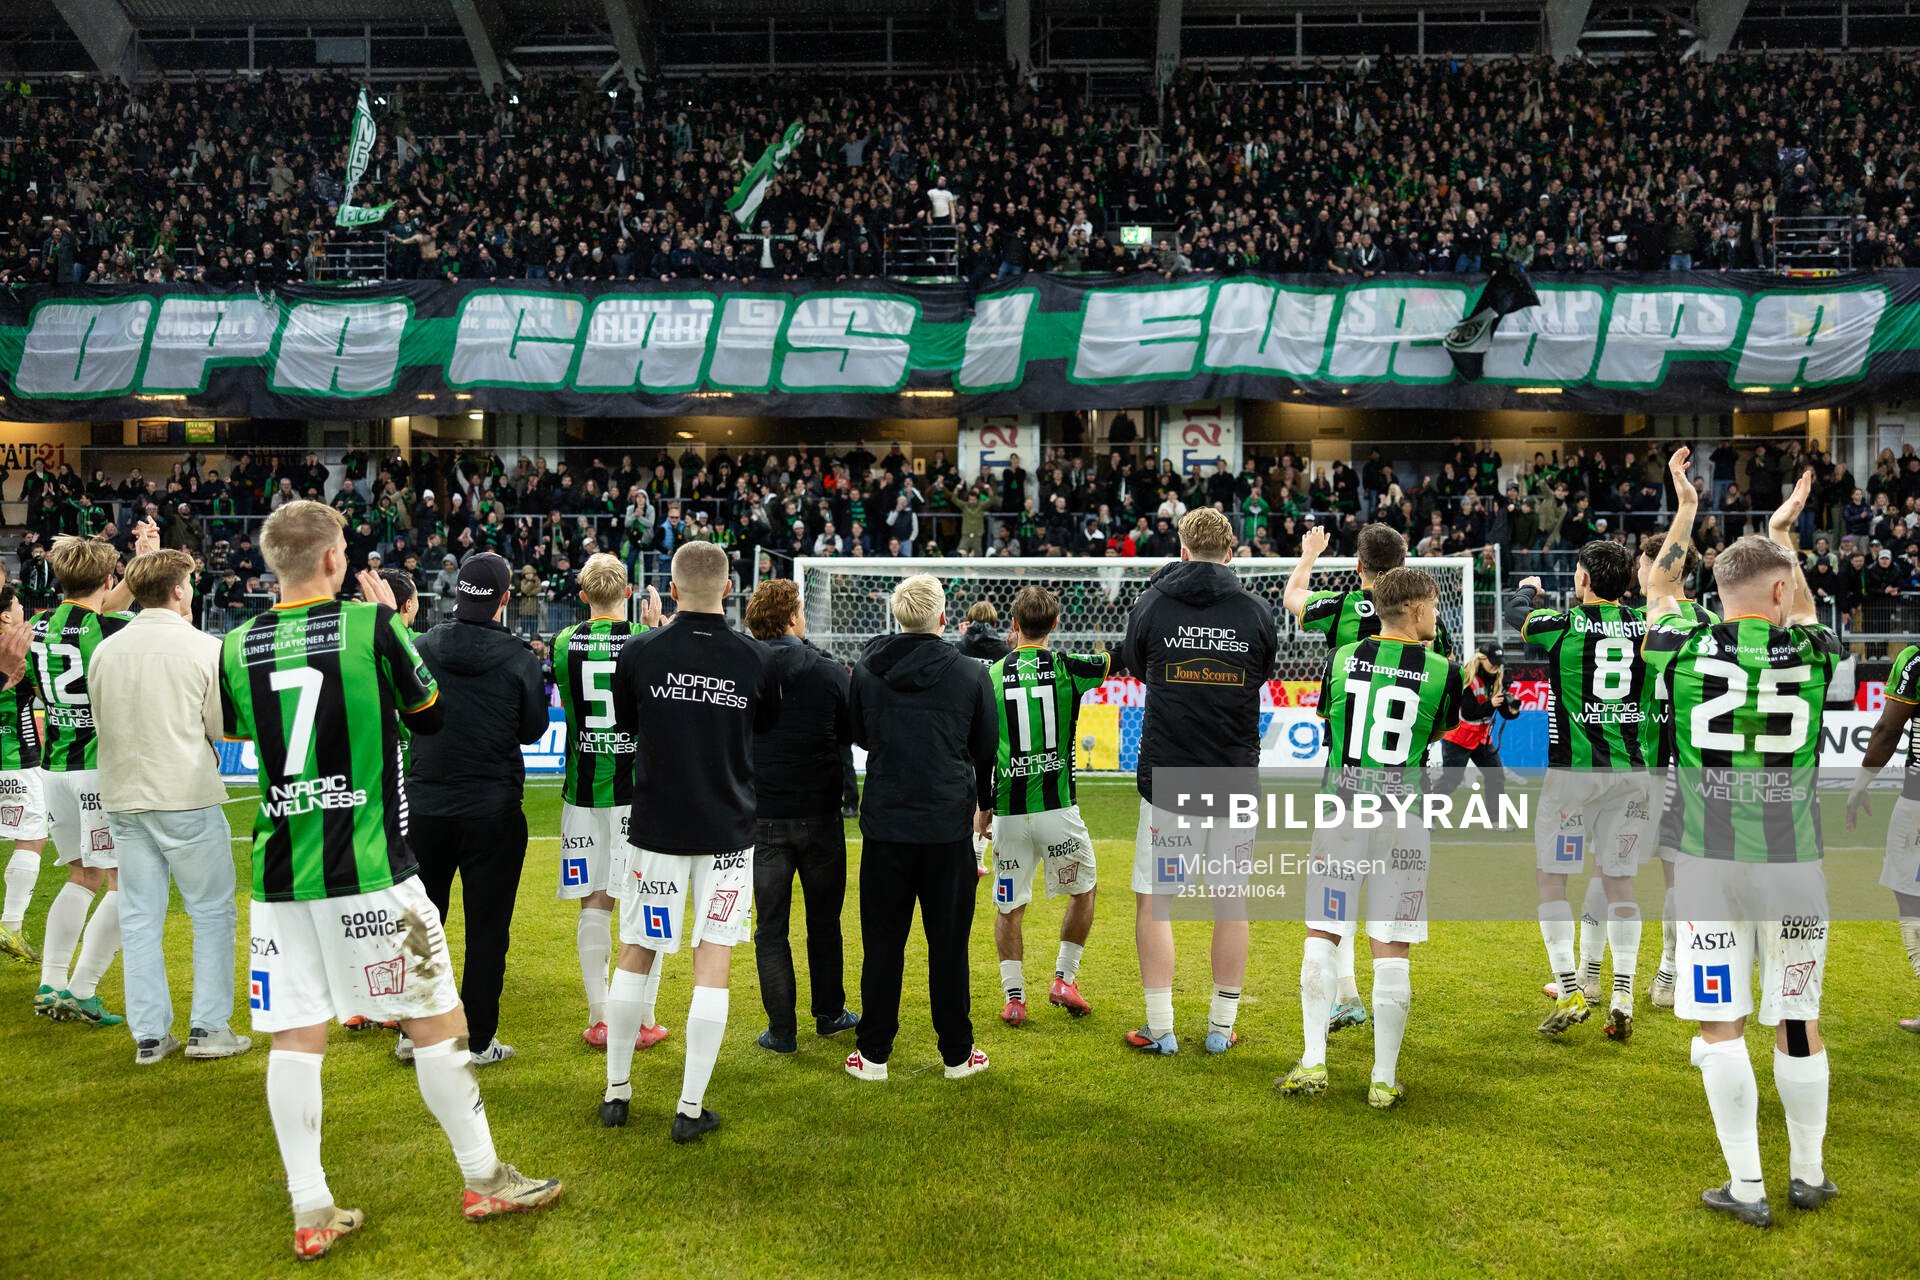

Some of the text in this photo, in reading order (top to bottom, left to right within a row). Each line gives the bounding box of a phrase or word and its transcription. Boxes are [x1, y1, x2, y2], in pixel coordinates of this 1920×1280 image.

[444, 288, 922, 393] GAIS
[1067, 276, 1892, 391] EUROPA
[1178, 626, 1236, 640] NORDIC
[1574, 615, 1647, 638] GARMEISTE
[568, 642, 596, 651] Mikael
[1164, 637, 1249, 652] WELLNESS
[31, 641, 90, 704] 12
[1018, 671, 1056, 681] VALVES
[1360, 661, 1429, 682] Tranpenad
[1593, 637, 1634, 700] 8
[667, 672, 735, 693] NORDIC
[582, 661, 617, 729] 5
[650, 685, 748, 709] WELLNESS
[1691, 656, 1811, 753] 25
[1585, 702, 1637, 713] NORDIC
[270, 667, 324, 776] 7
[1005, 685, 1057, 752] 11
[1344, 679, 1420, 765] 18
[1572, 711, 1645, 724] WELLNESS
[579, 731, 630, 743] NORDIC
[1001, 758, 1066, 778] WELLNESS
[1011, 751, 1057, 767] NORDIC
[1343, 764, 1402, 783] NORDIC
[1706, 768, 1789, 787] NORDIC
[1691, 781, 1807, 803] WELLNESS
[1151, 834, 1192, 848] RASTA
[341, 909, 388, 926] GOOD
[1782, 915, 1819, 927] GOOD
[344, 919, 407, 939] ADVICE
[1780, 927, 1826, 940] ADVICE
[1691, 931, 1736, 950] ASTA
